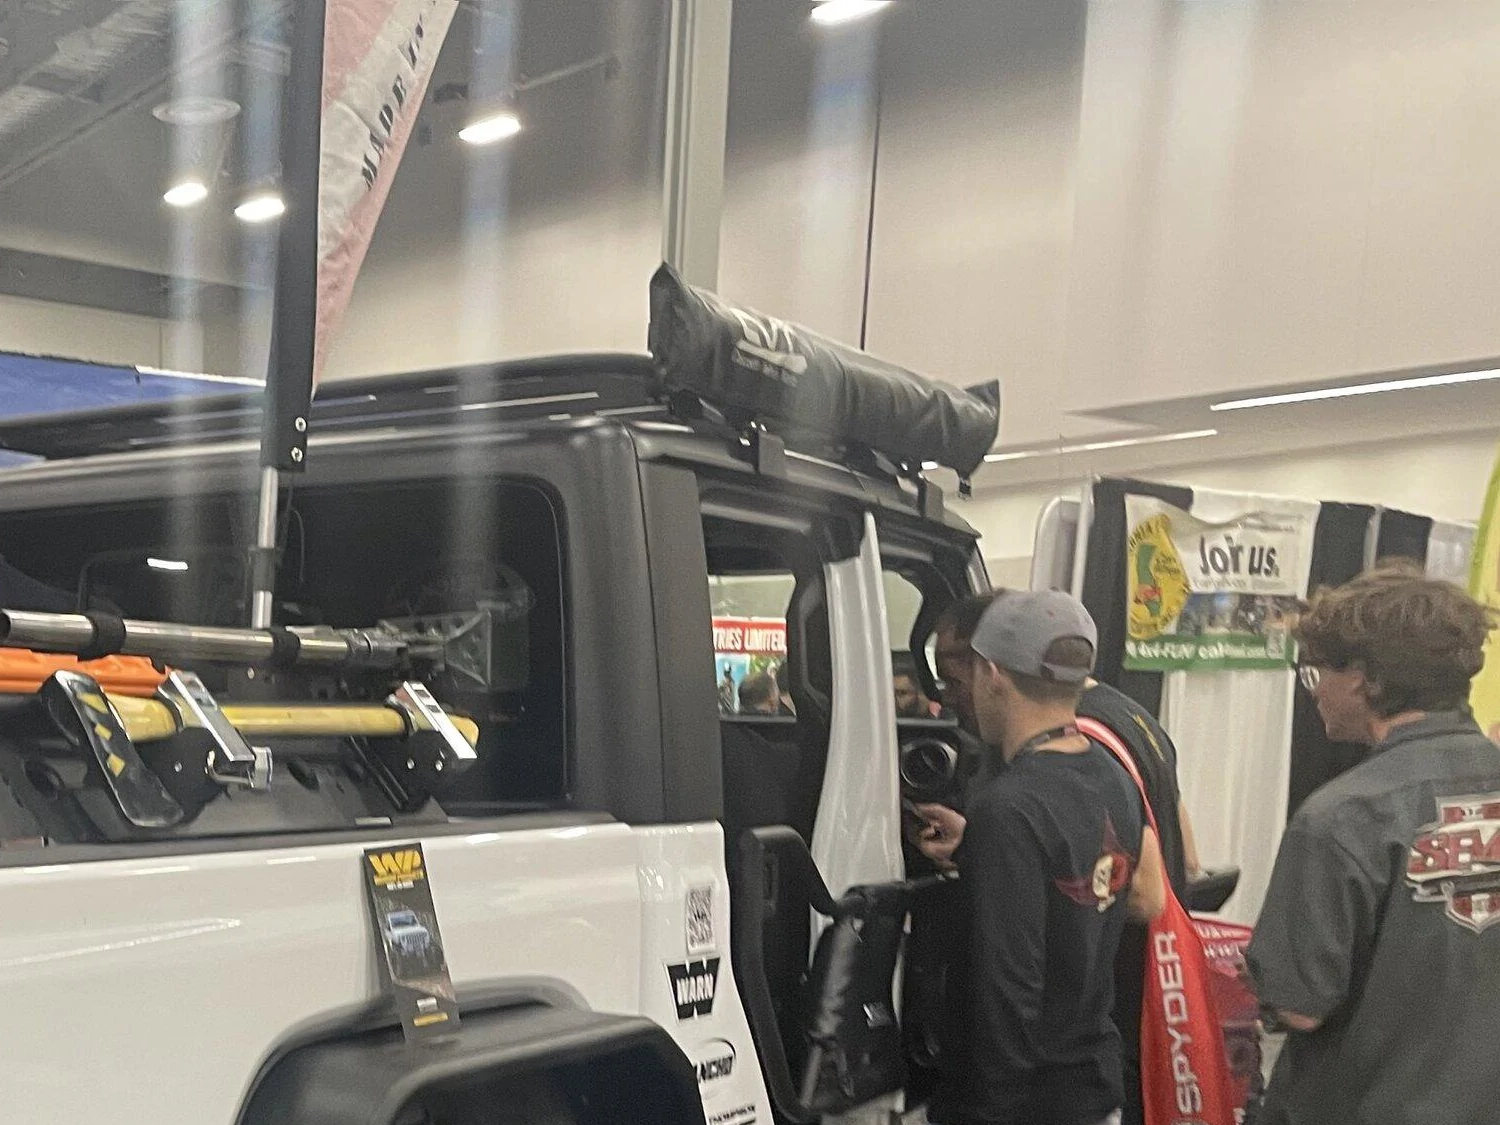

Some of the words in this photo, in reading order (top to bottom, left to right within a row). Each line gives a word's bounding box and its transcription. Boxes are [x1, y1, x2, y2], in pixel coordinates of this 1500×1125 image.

[362, 74, 407, 192] MADE
[1408, 824, 1500, 875] SEM
[675, 972, 714, 1006] WARN
[1153, 929, 1203, 1115] SPYDER
